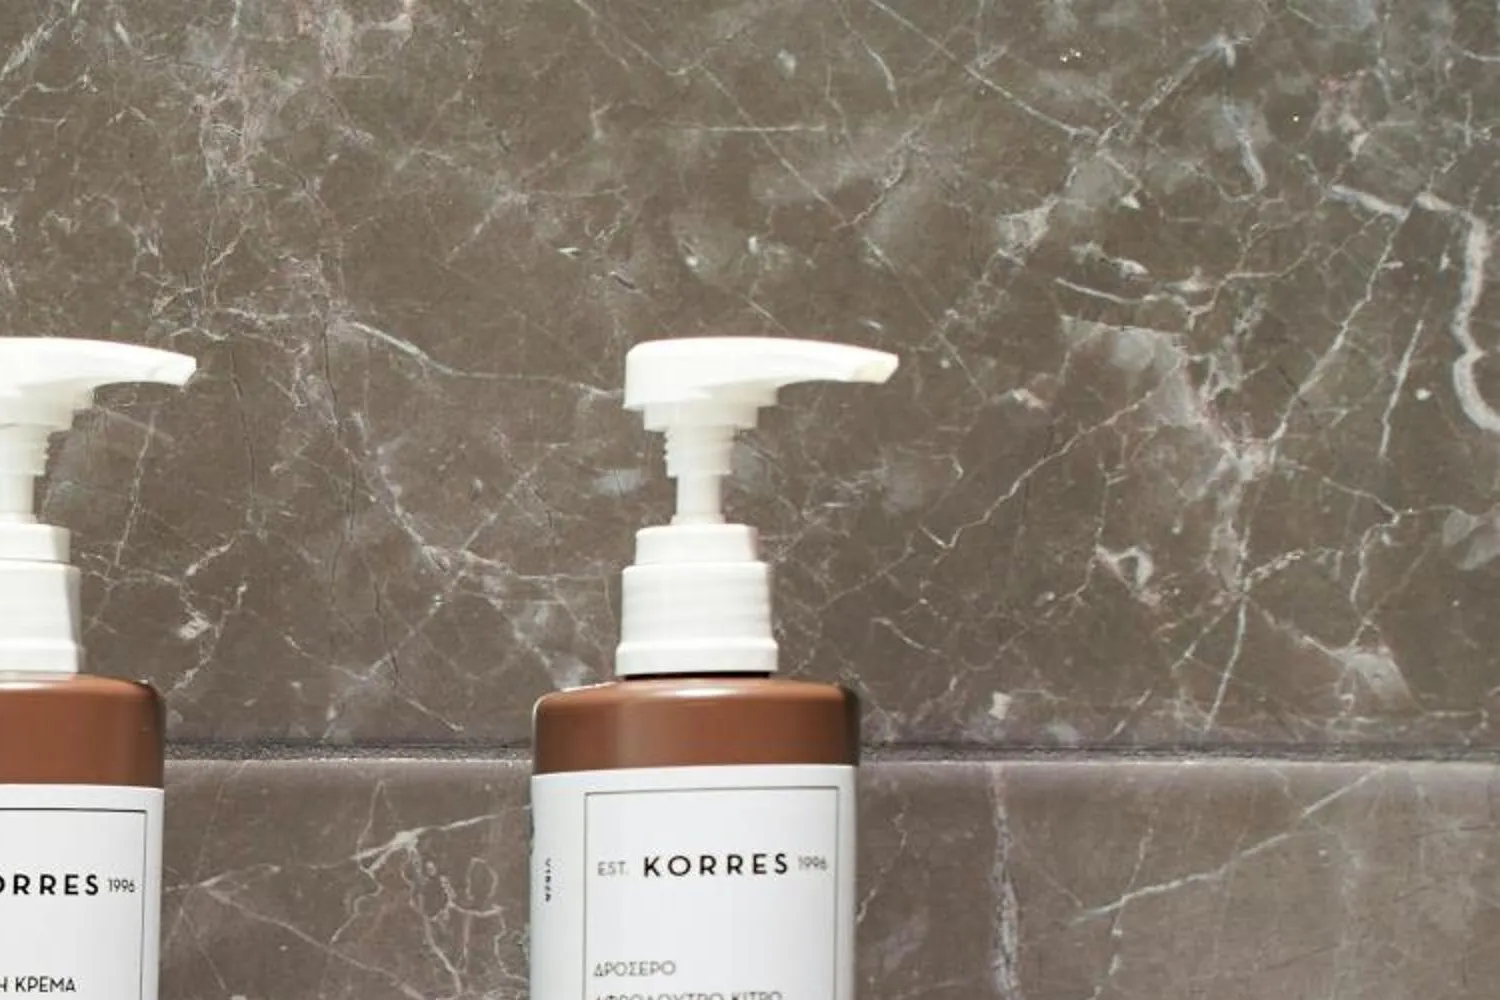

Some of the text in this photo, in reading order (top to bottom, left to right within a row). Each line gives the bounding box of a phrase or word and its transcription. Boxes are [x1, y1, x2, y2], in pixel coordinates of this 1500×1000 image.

[597, 853, 828, 877] EST. KORRES 1996
[108, 878, 136, 893] 1996
[593, 960, 676, 977] ΔΡΟΣΕΡΟ
[15, 976, 76, 993] ΚΡΕΜΑ
